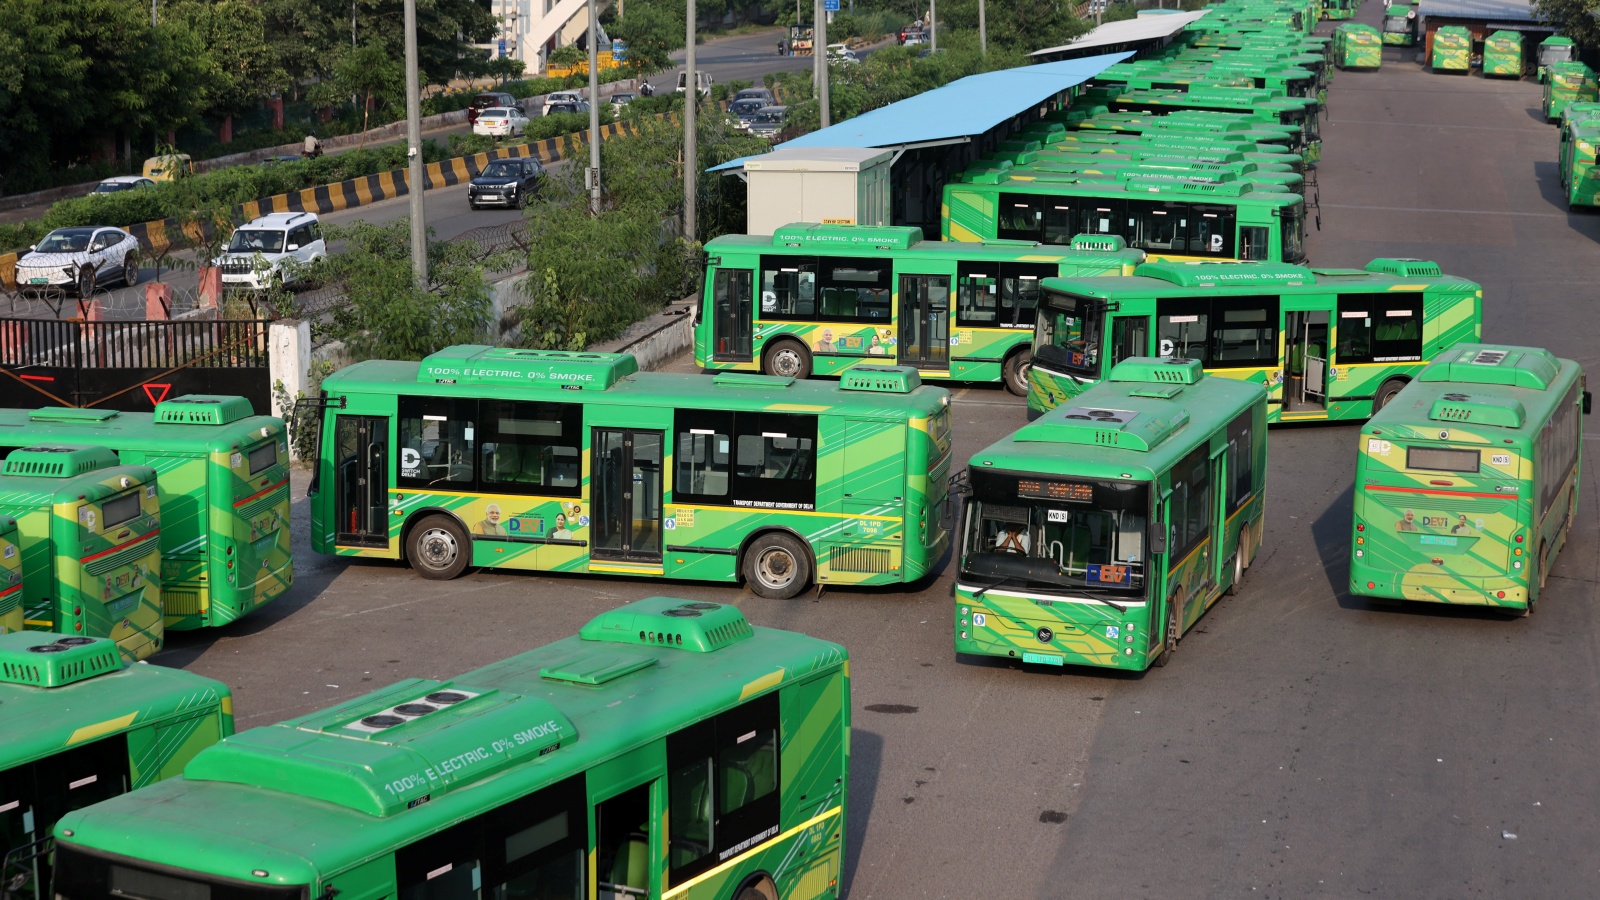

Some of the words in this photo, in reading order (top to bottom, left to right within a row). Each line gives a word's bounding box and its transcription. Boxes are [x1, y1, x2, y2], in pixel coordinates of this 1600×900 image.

[464, 369, 523, 378] ELECTRIC.
[549, 372, 595, 382] SMOKE.
[385, 773, 426, 796] 100%
[425, 747, 492, 781] ELECTRIC.
[492, 737, 515, 753] 0%
[513, 720, 563, 745] SMOKE.
